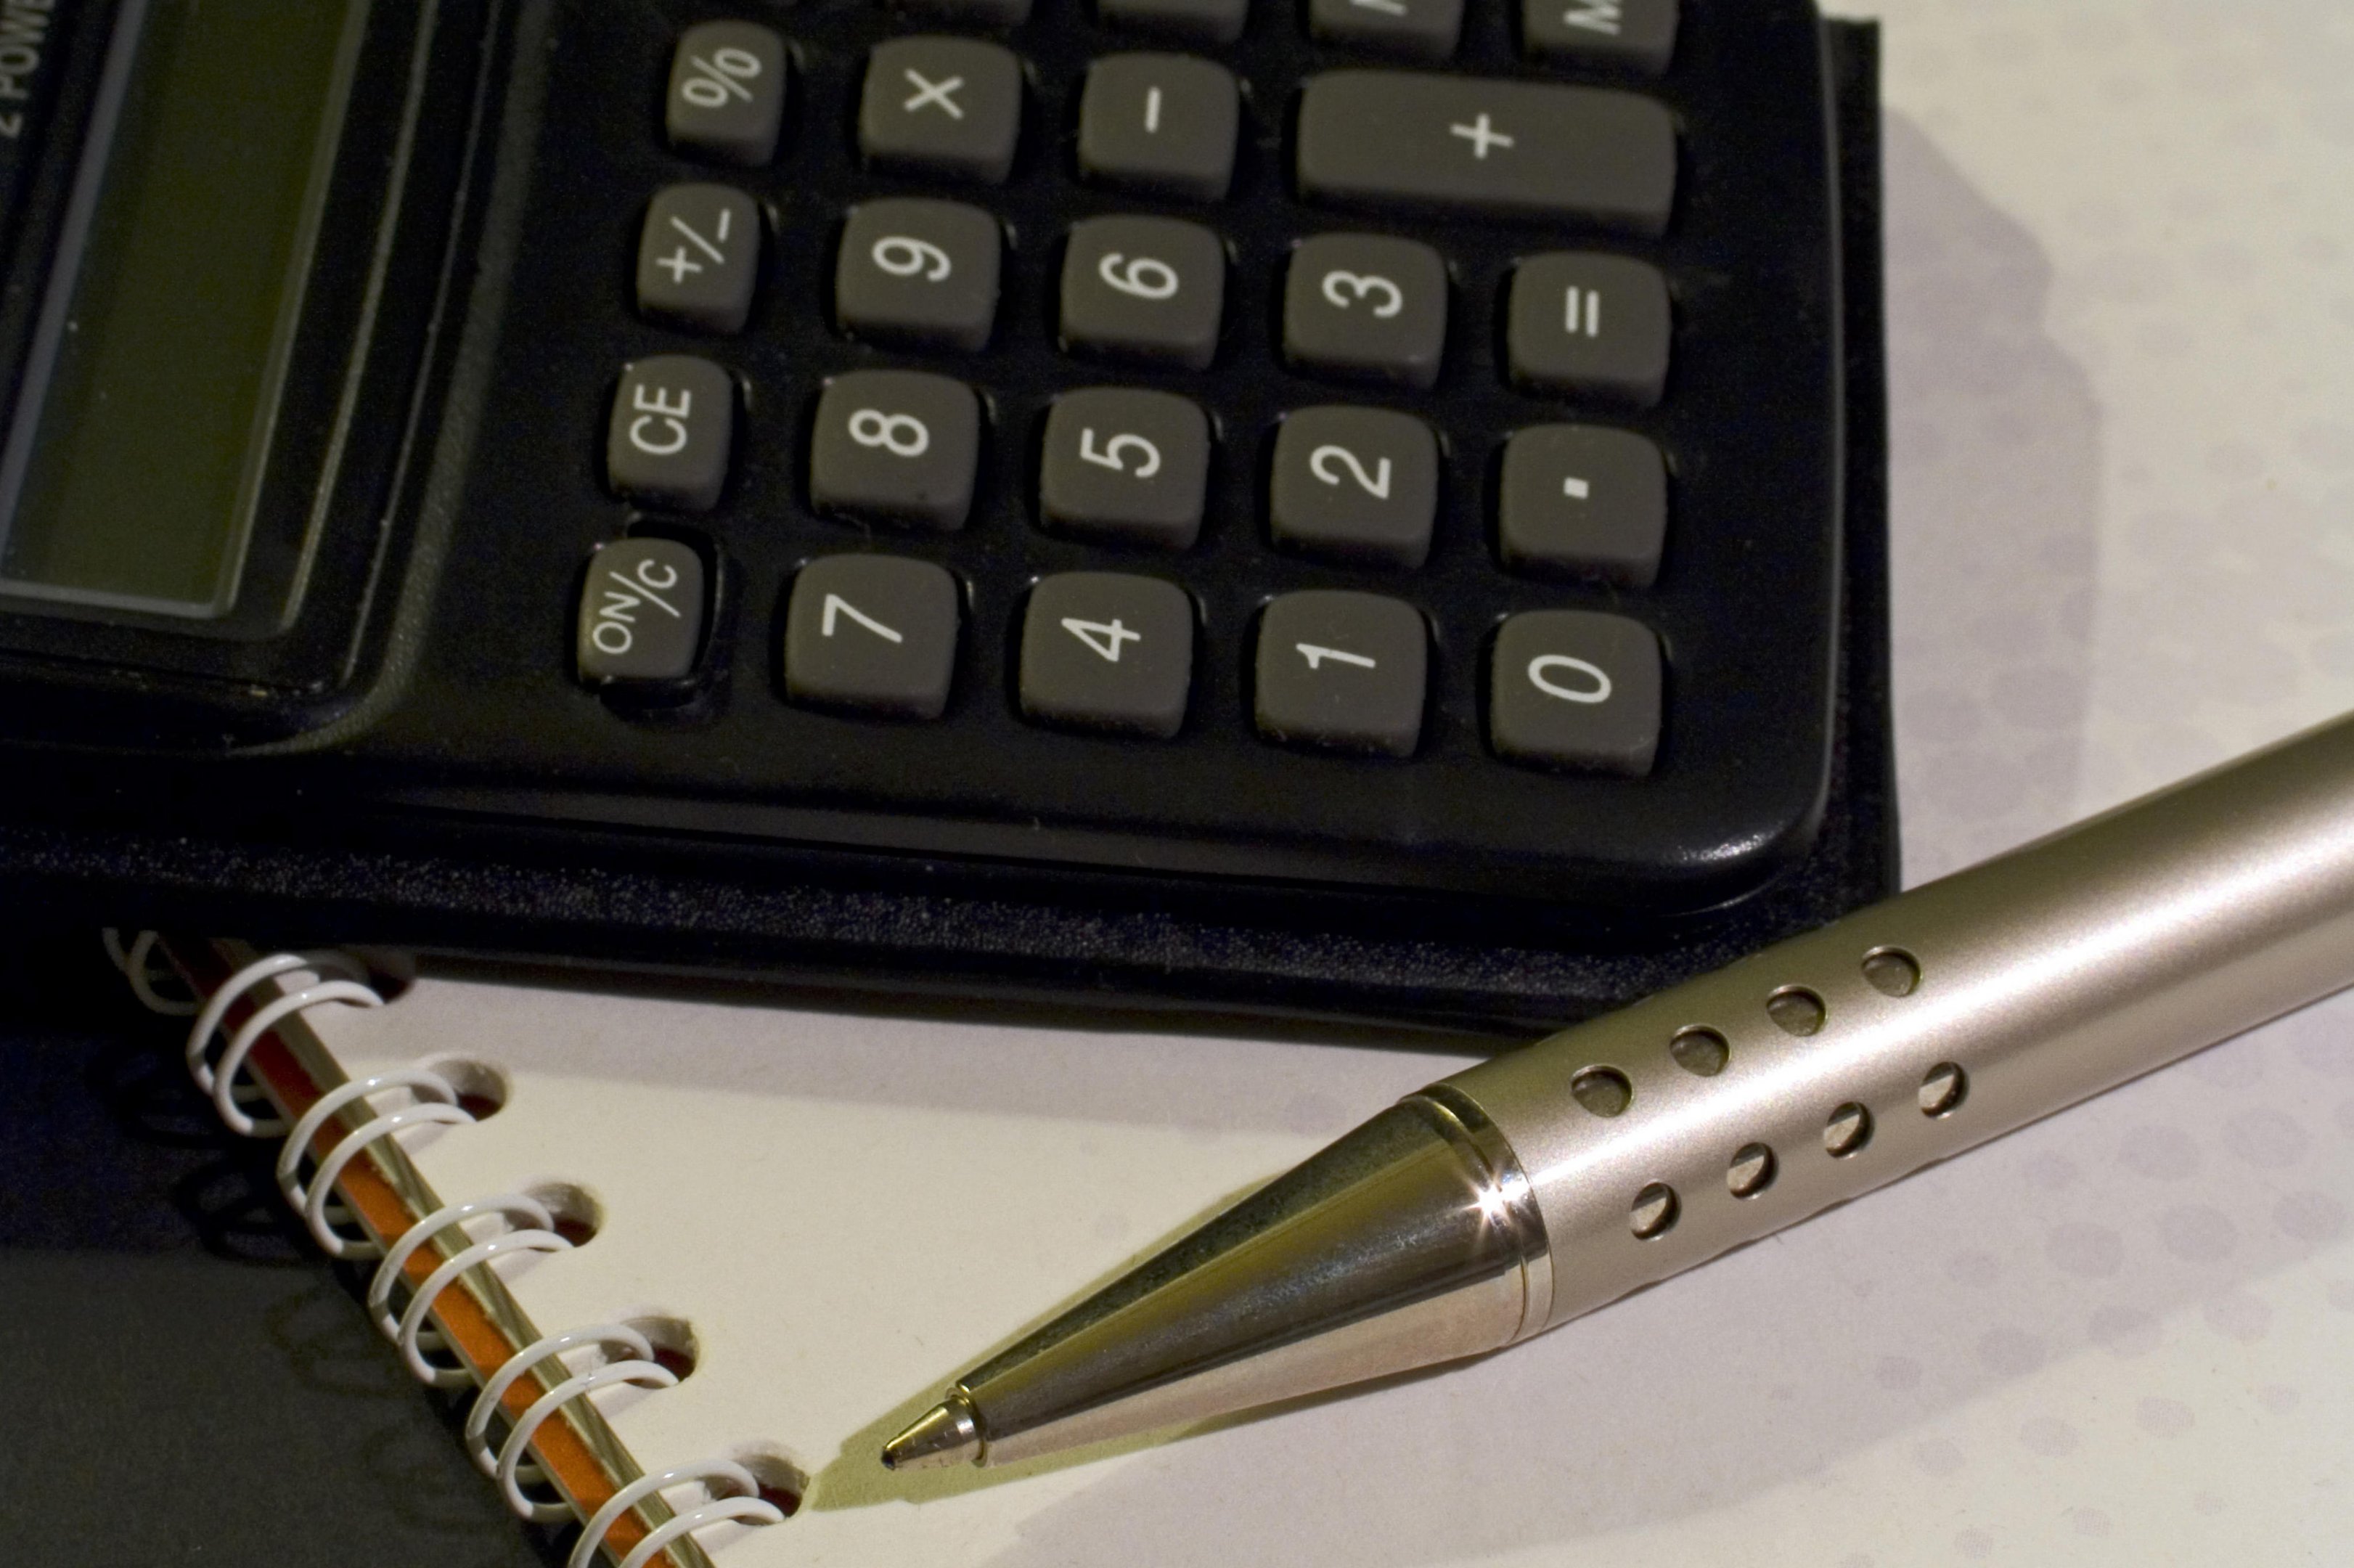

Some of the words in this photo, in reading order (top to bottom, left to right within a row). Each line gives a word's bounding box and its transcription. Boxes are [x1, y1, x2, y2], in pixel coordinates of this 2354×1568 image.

[681, 48, 761, 107] %
[656, 209, 730, 282] +/-
[872, 236, 951, 282] 9
[1099, 253, 1178, 299] 6
[1322, 270, 1402, 318] 3
[629, 385, 691, 455] CE
[849, 409, 929, 457] 8
[1080, 428, 1160, 478] 5
[1310, 445, 1391, 499] 2
[592, 560, 680, 654] ON/C
[822, 594, 902, 643] 7
[1061, 618, 1140, 661] 4
[1296, 643, 1376, 669] 1
[1528, 655, 1611, 703] 0
